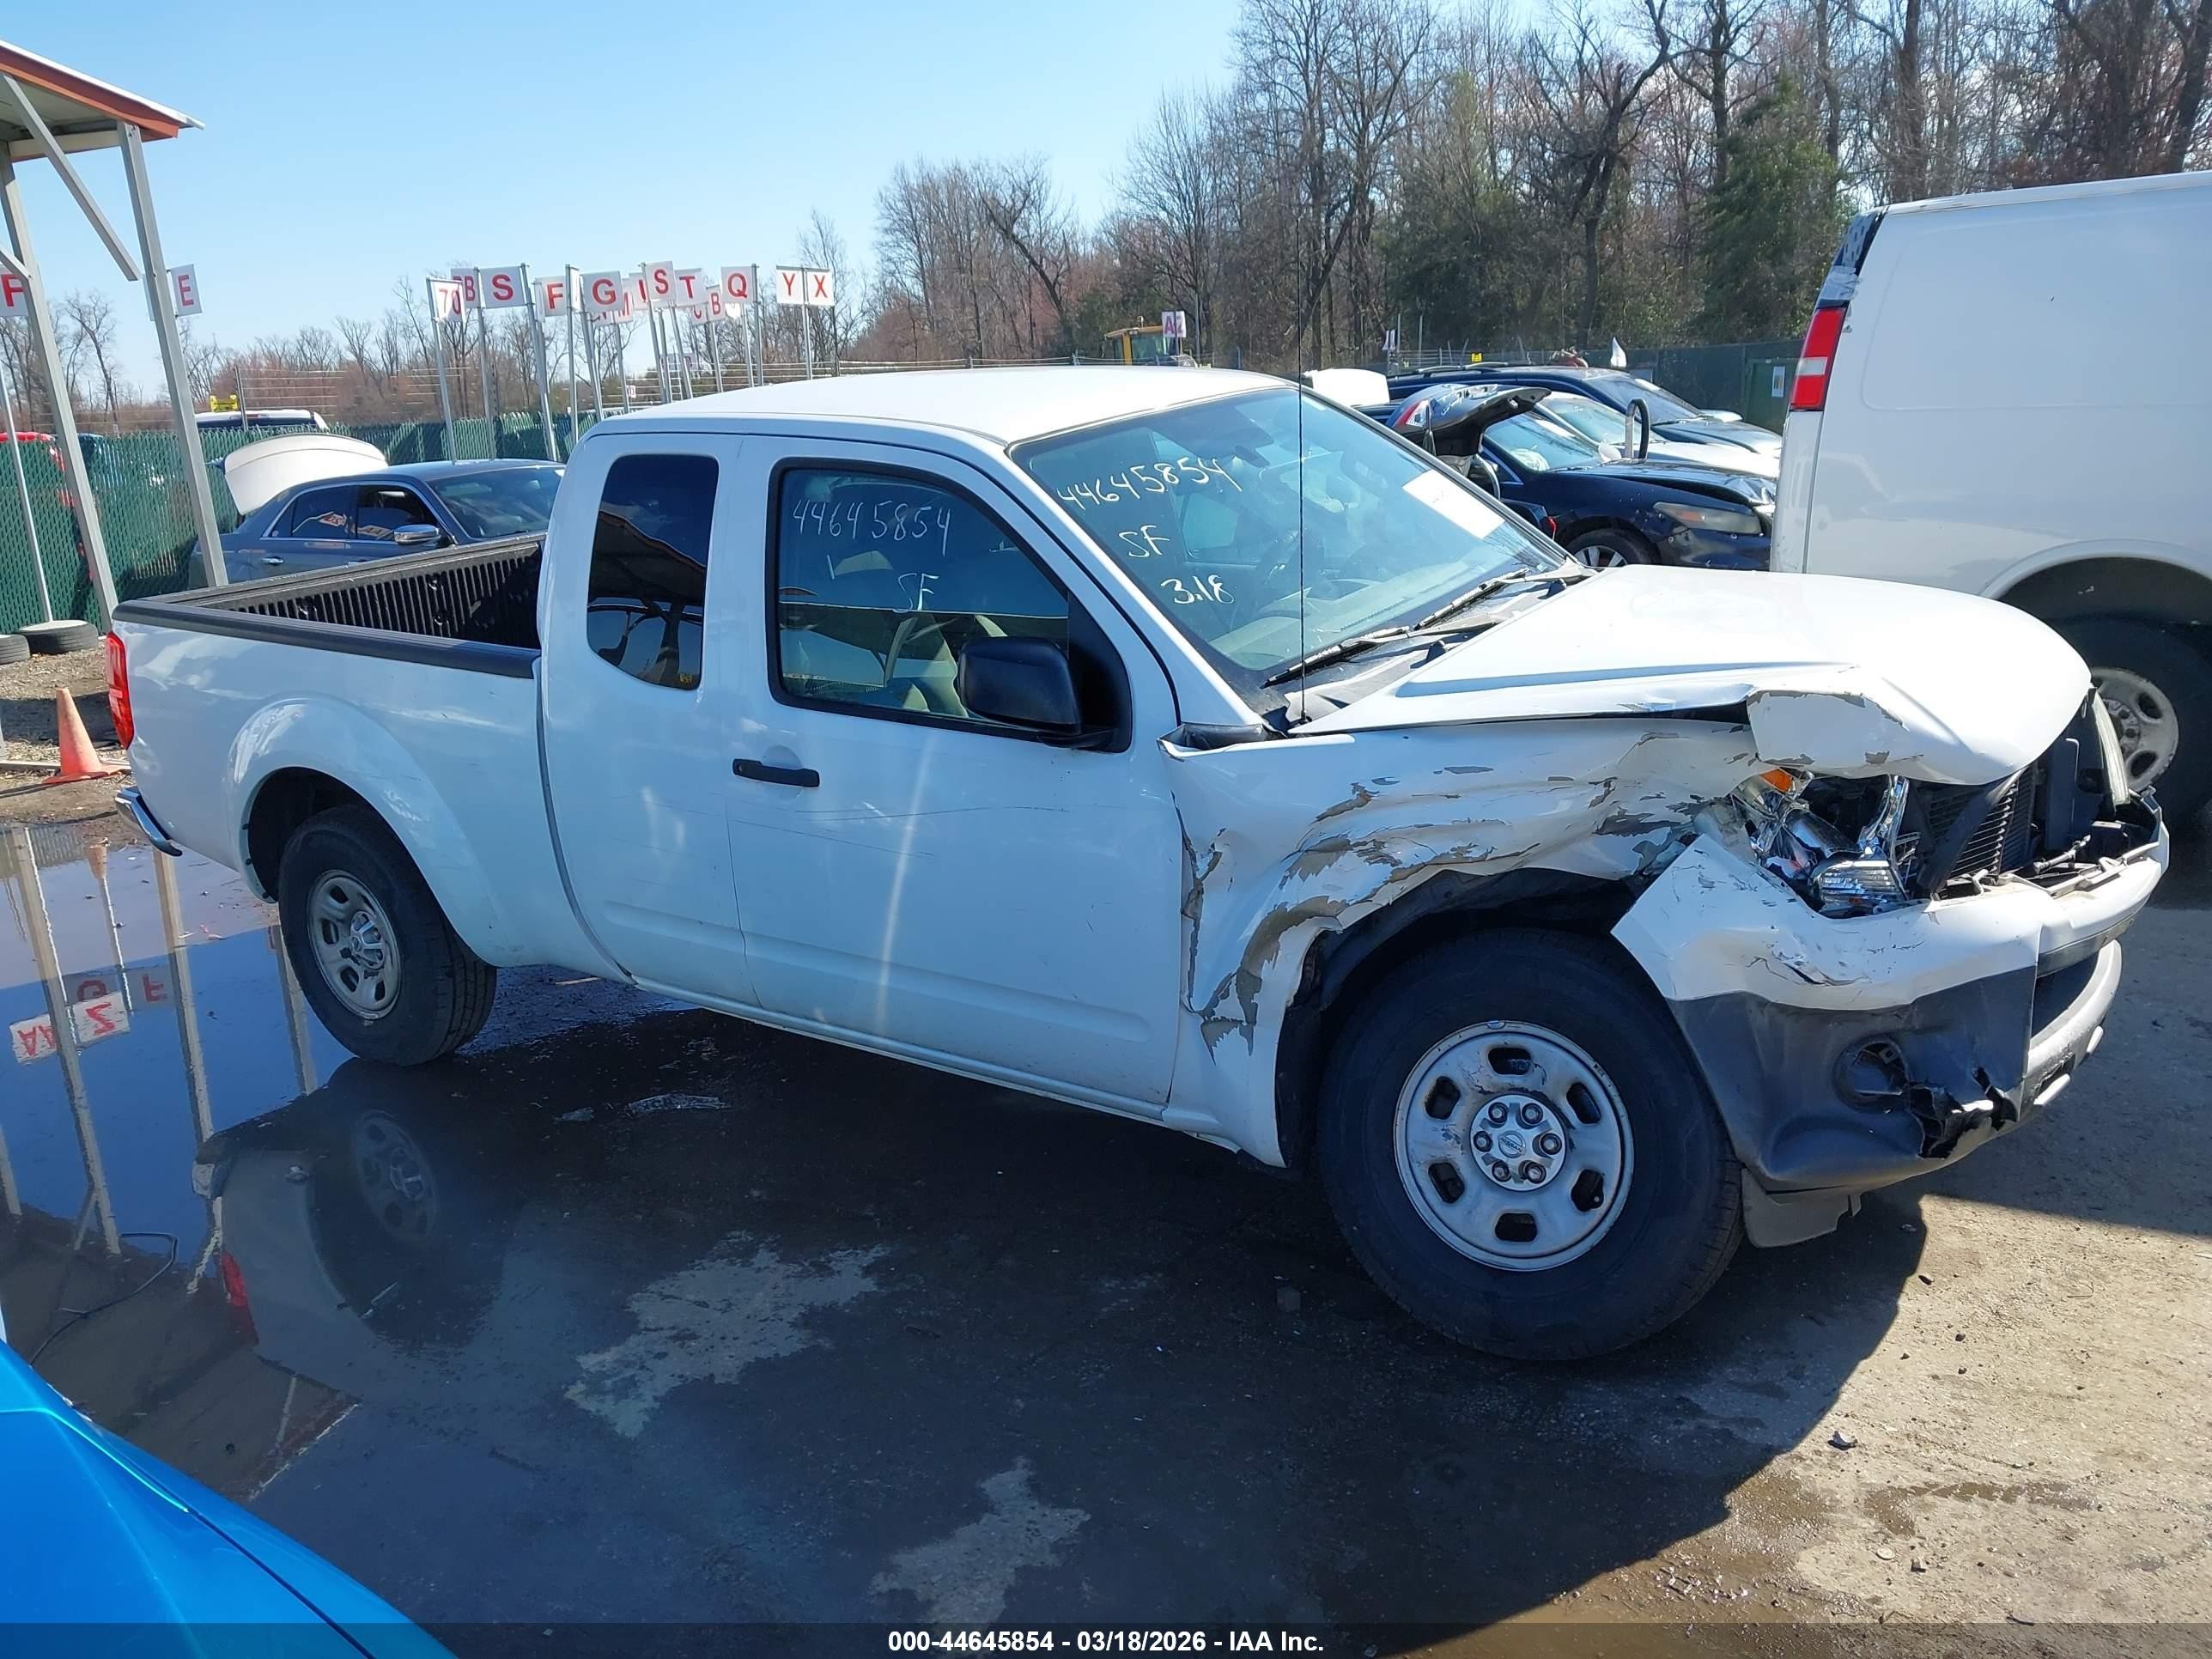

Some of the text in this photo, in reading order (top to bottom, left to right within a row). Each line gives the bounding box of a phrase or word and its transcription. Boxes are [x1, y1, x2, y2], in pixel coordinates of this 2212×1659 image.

[178, 275, 193, 306] E
[491, 274, 514, 301] S
[592, 278, 617, 305] G
[653, 269, 669, 294] S
[678, 276, 695, 299] T
[727, 273, 747, 298] Q
[782, 272, 796, 296] Y
[813, 274, 828, 298] X
[547, 283, 563, 309] F
[1057, 457, 1243, 510] 44645854
[793, 499, 951, 556] 44645854
[1118, 525, 1170, 557] SF
[896, 573, 941, 613] SF
